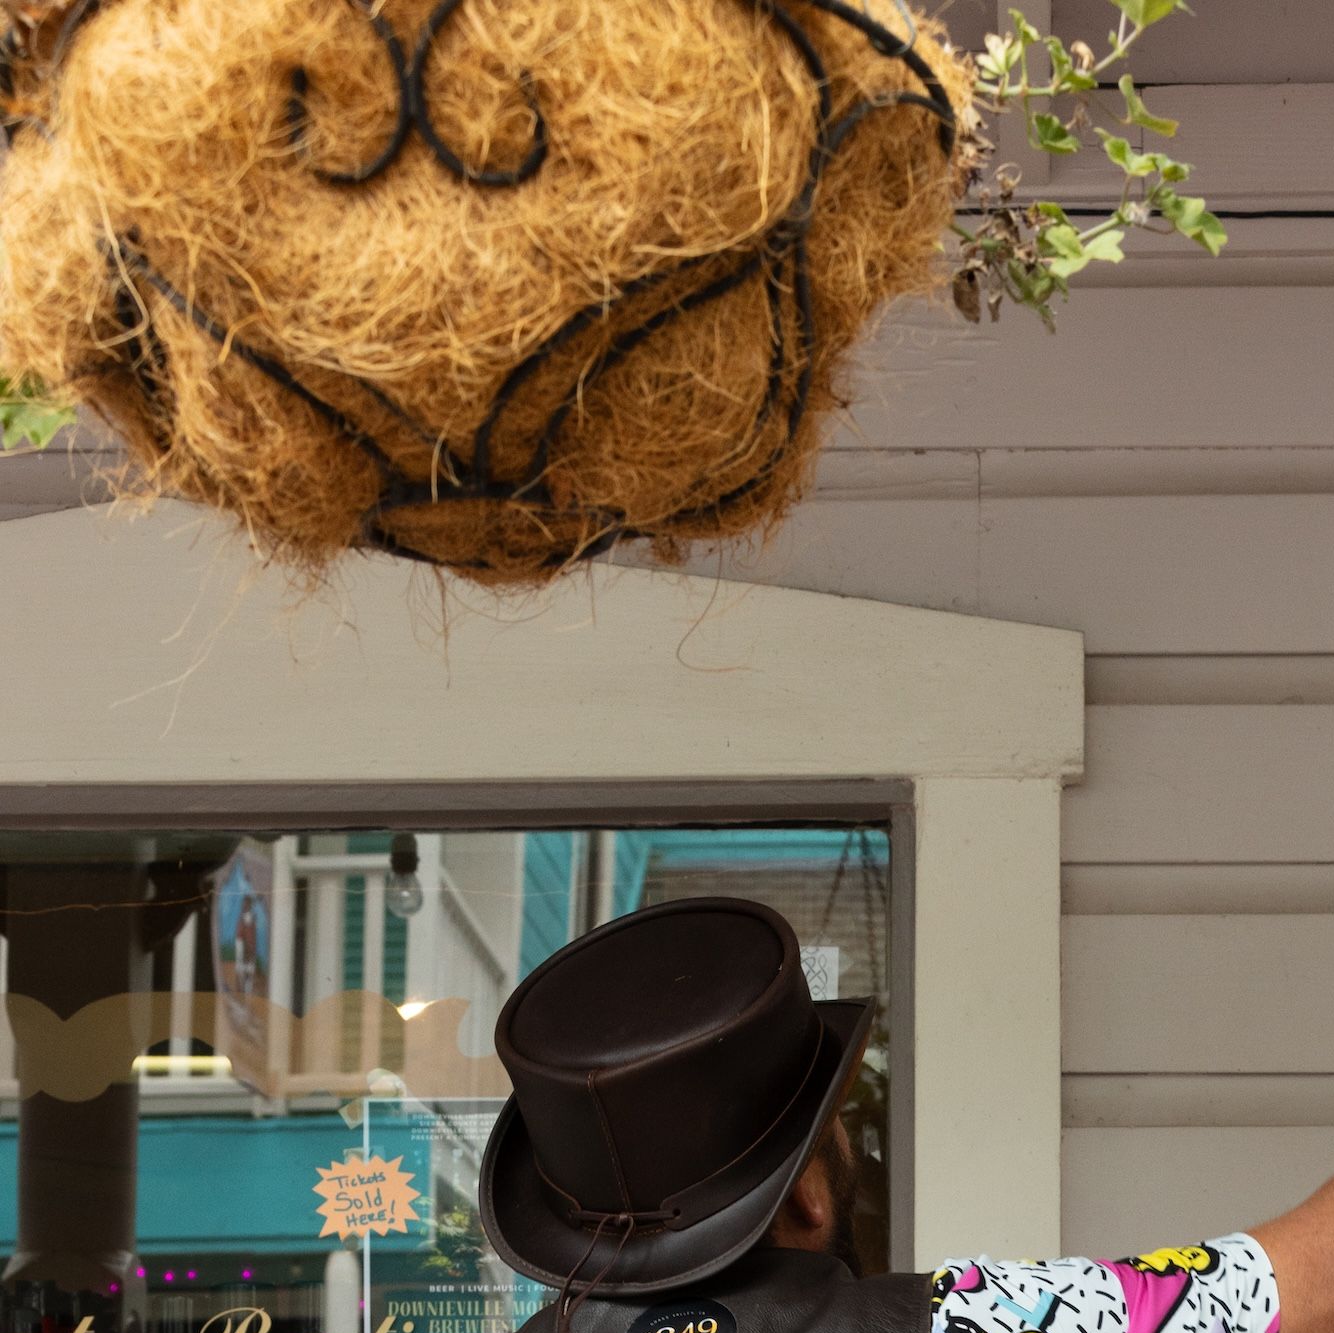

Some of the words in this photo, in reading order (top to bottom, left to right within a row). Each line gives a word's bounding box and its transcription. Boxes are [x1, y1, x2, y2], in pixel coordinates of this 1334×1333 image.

[327, 1172, 386, 1189] Tickets
[334, 1188, 382, 1212] Sold
[429, 1285, 455, 1293] BEER
[468, 1284, 490, 1293] LIVE
[493, 1284, 525, 1293] MUSIC
[388, 1301, 505, 1317] DOWNIEVILLE
